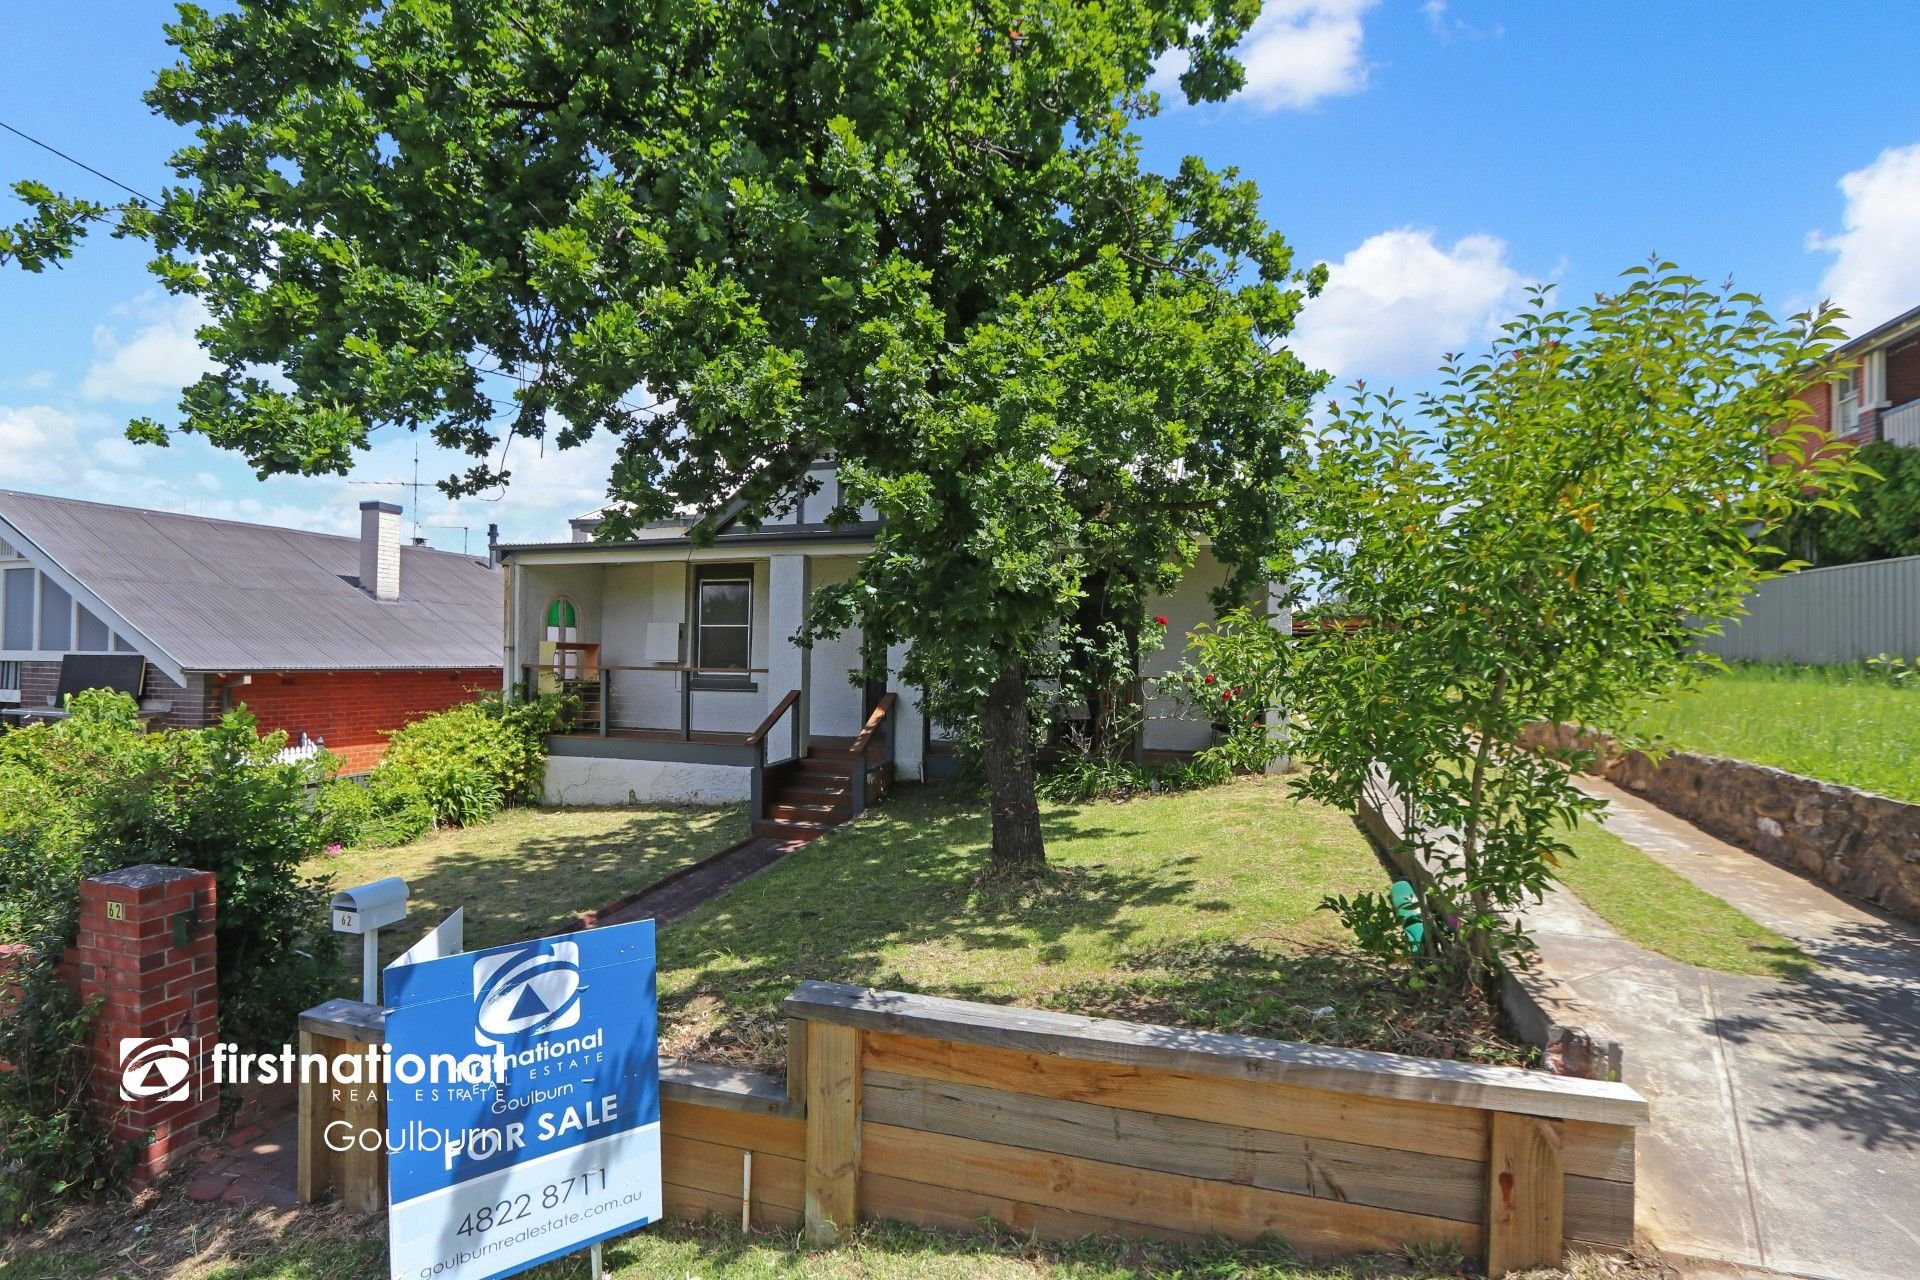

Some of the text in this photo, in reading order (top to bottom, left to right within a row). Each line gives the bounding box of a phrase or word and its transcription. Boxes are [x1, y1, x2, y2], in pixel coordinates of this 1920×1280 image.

[109, 902, 121, 919] 62
[341, 914, 352, 927] 62
[529, 1052, 604, 1080] ESTATE
[491, 1083, 574, 1115] Goulburn
[444, 1094, 618, 1171] FOR SALE
[456, 1167, 607, 1237] 4822 8711
[420, 1190, 643, 1280] goulburnrealestate.com.au
